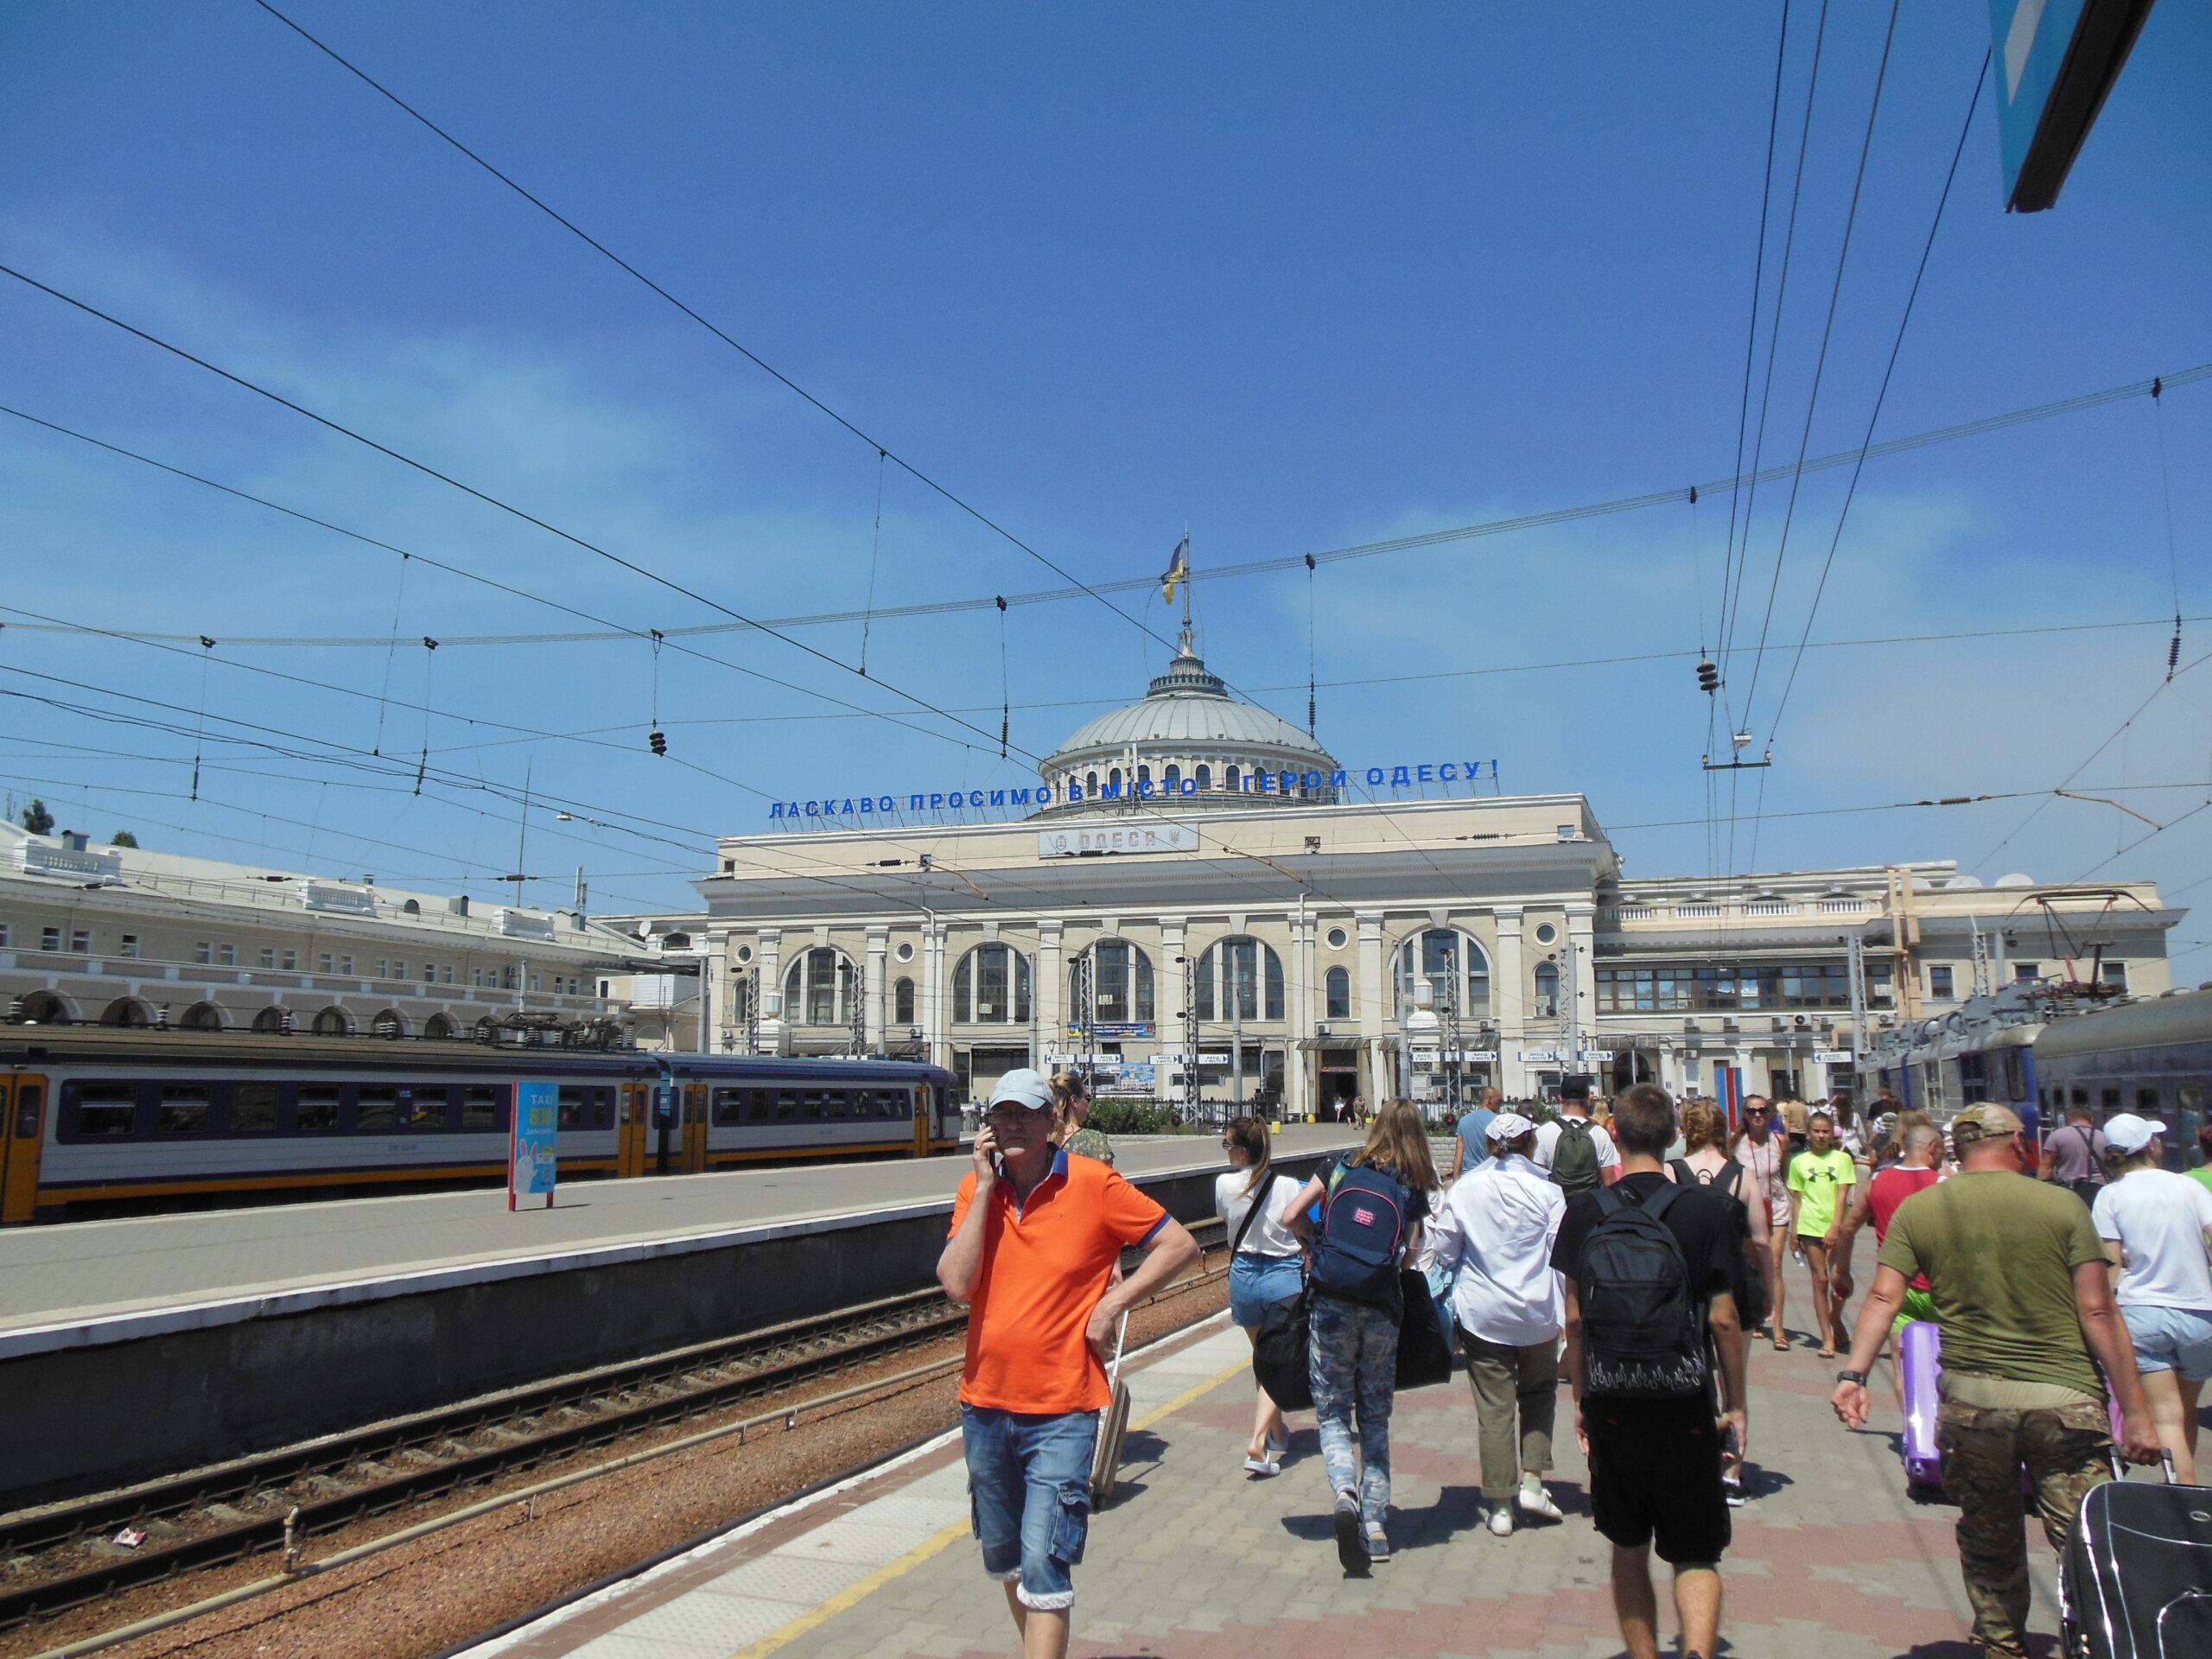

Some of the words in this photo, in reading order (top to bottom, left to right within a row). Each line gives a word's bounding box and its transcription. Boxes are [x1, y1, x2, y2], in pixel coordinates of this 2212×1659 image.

[769, 795, 895, 819] ЛАСКАВО
[910, 786, 1052, 810] ПРОСИМО
[1069, 784, 1084, 801] В
[1101, 778, 1198, 799] МІСТО
[1243, 763, 1346, 792] ГЕРОЙ
[1366, 759, 1497, 788] ОДЕСУ!
[1079, 830, 1156, 849] ОДЕСА
[531, 1094, 553, 1106] TAXI
